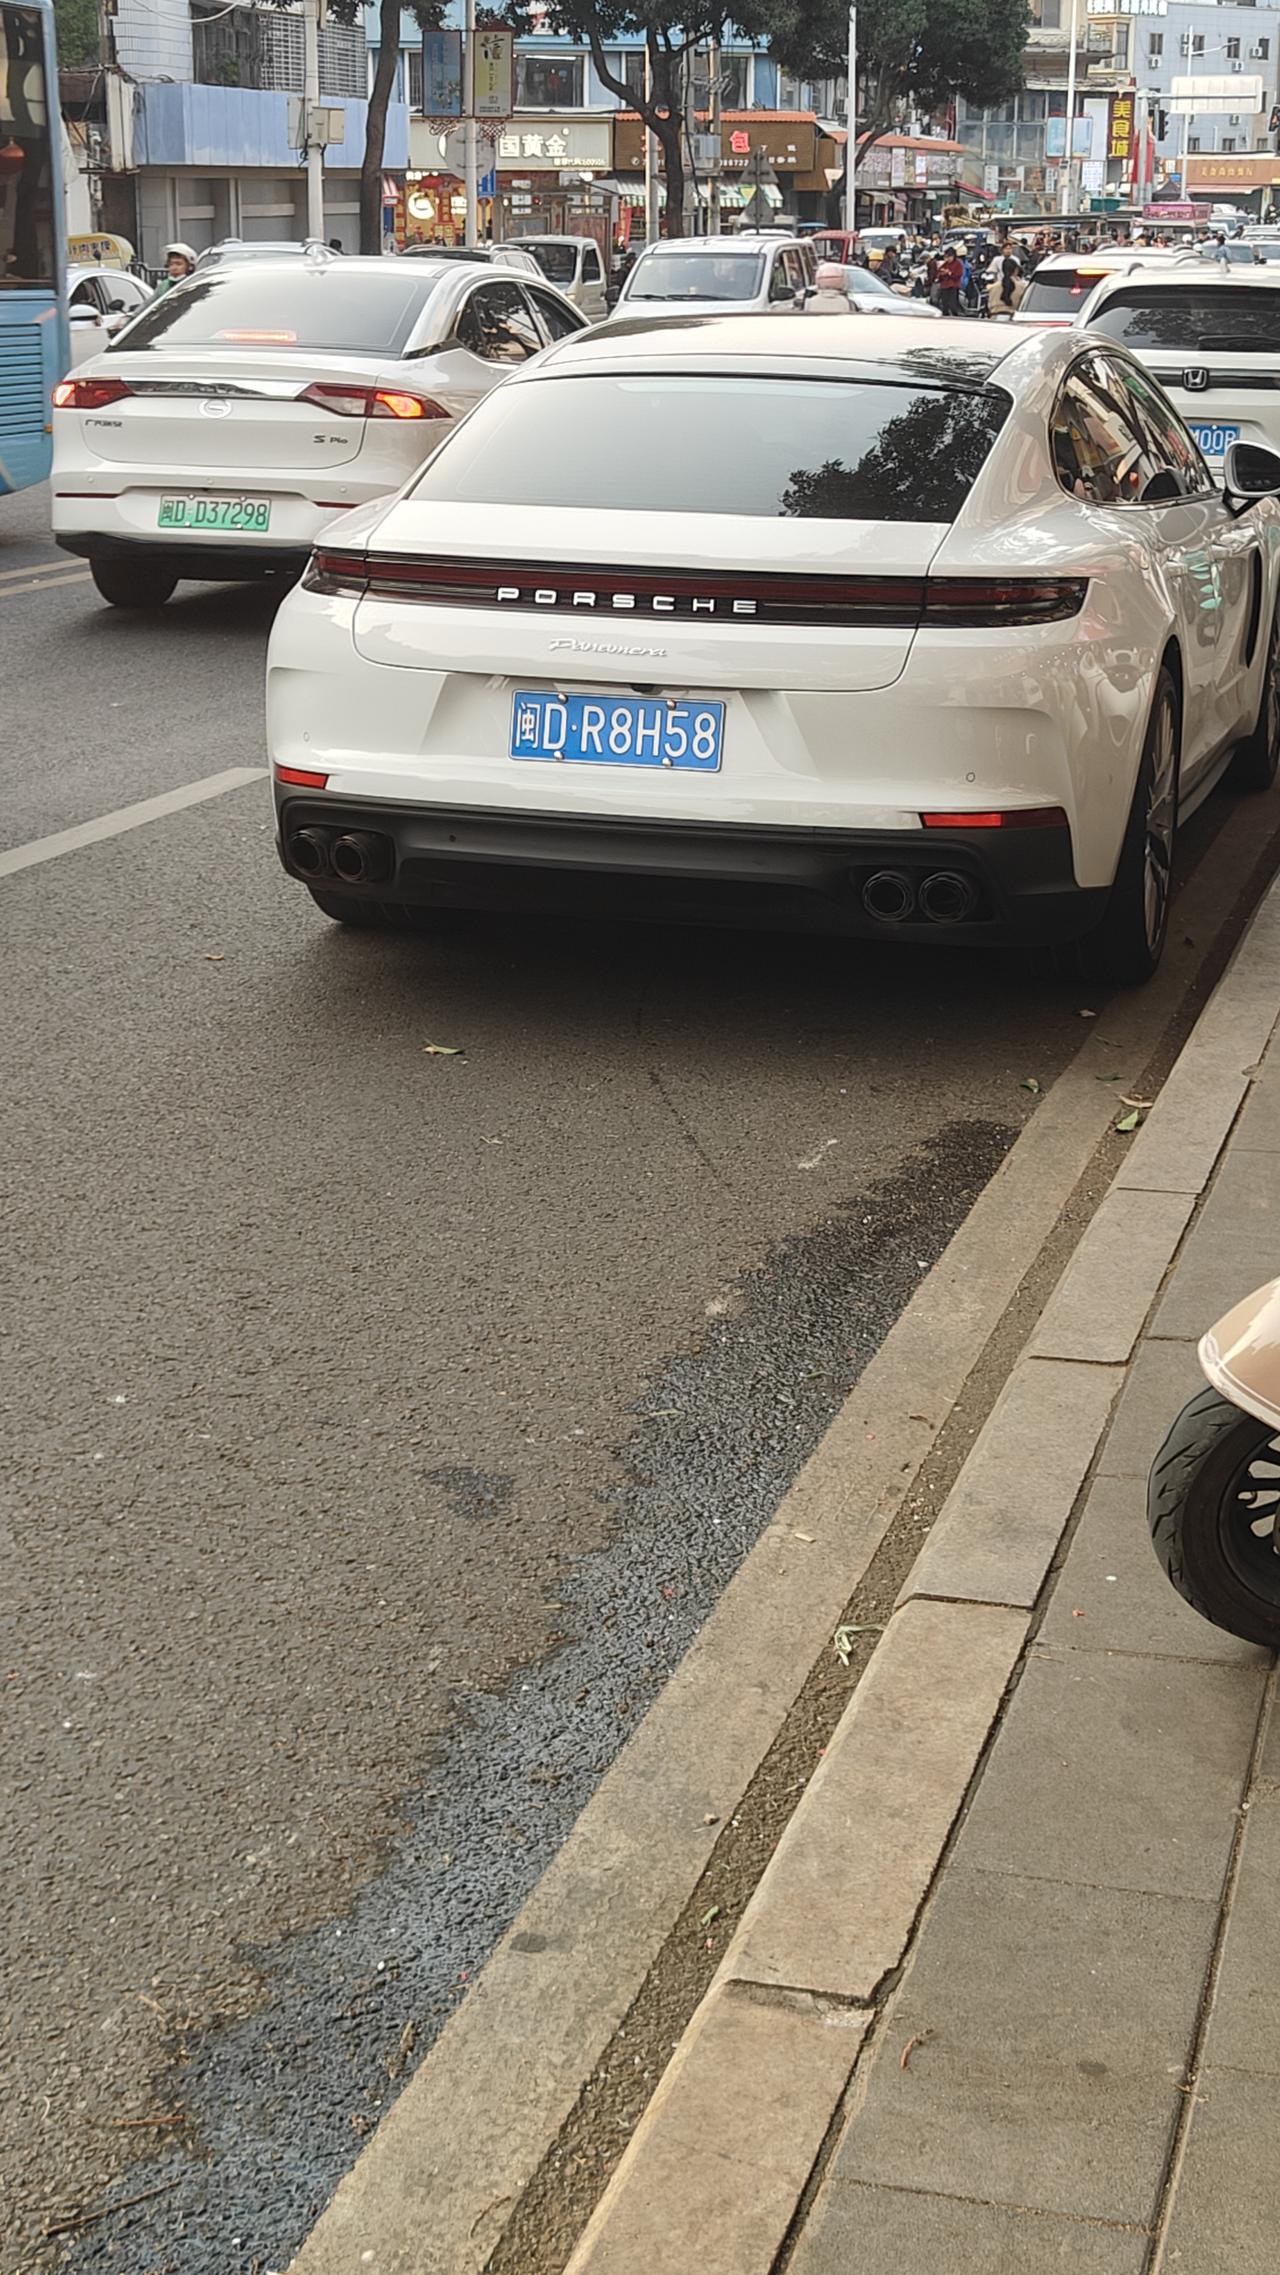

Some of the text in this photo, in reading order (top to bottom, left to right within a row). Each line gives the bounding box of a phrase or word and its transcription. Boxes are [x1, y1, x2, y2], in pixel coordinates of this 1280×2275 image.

[1110, 100, 1132, 157] 美食城
[313, 435, 326, 443] S
[497, 587, 757, 614] PORSCHE
[548, 637, 668, 657] Panamera
[515, 701, 717, 760] 闽D·R8H58
